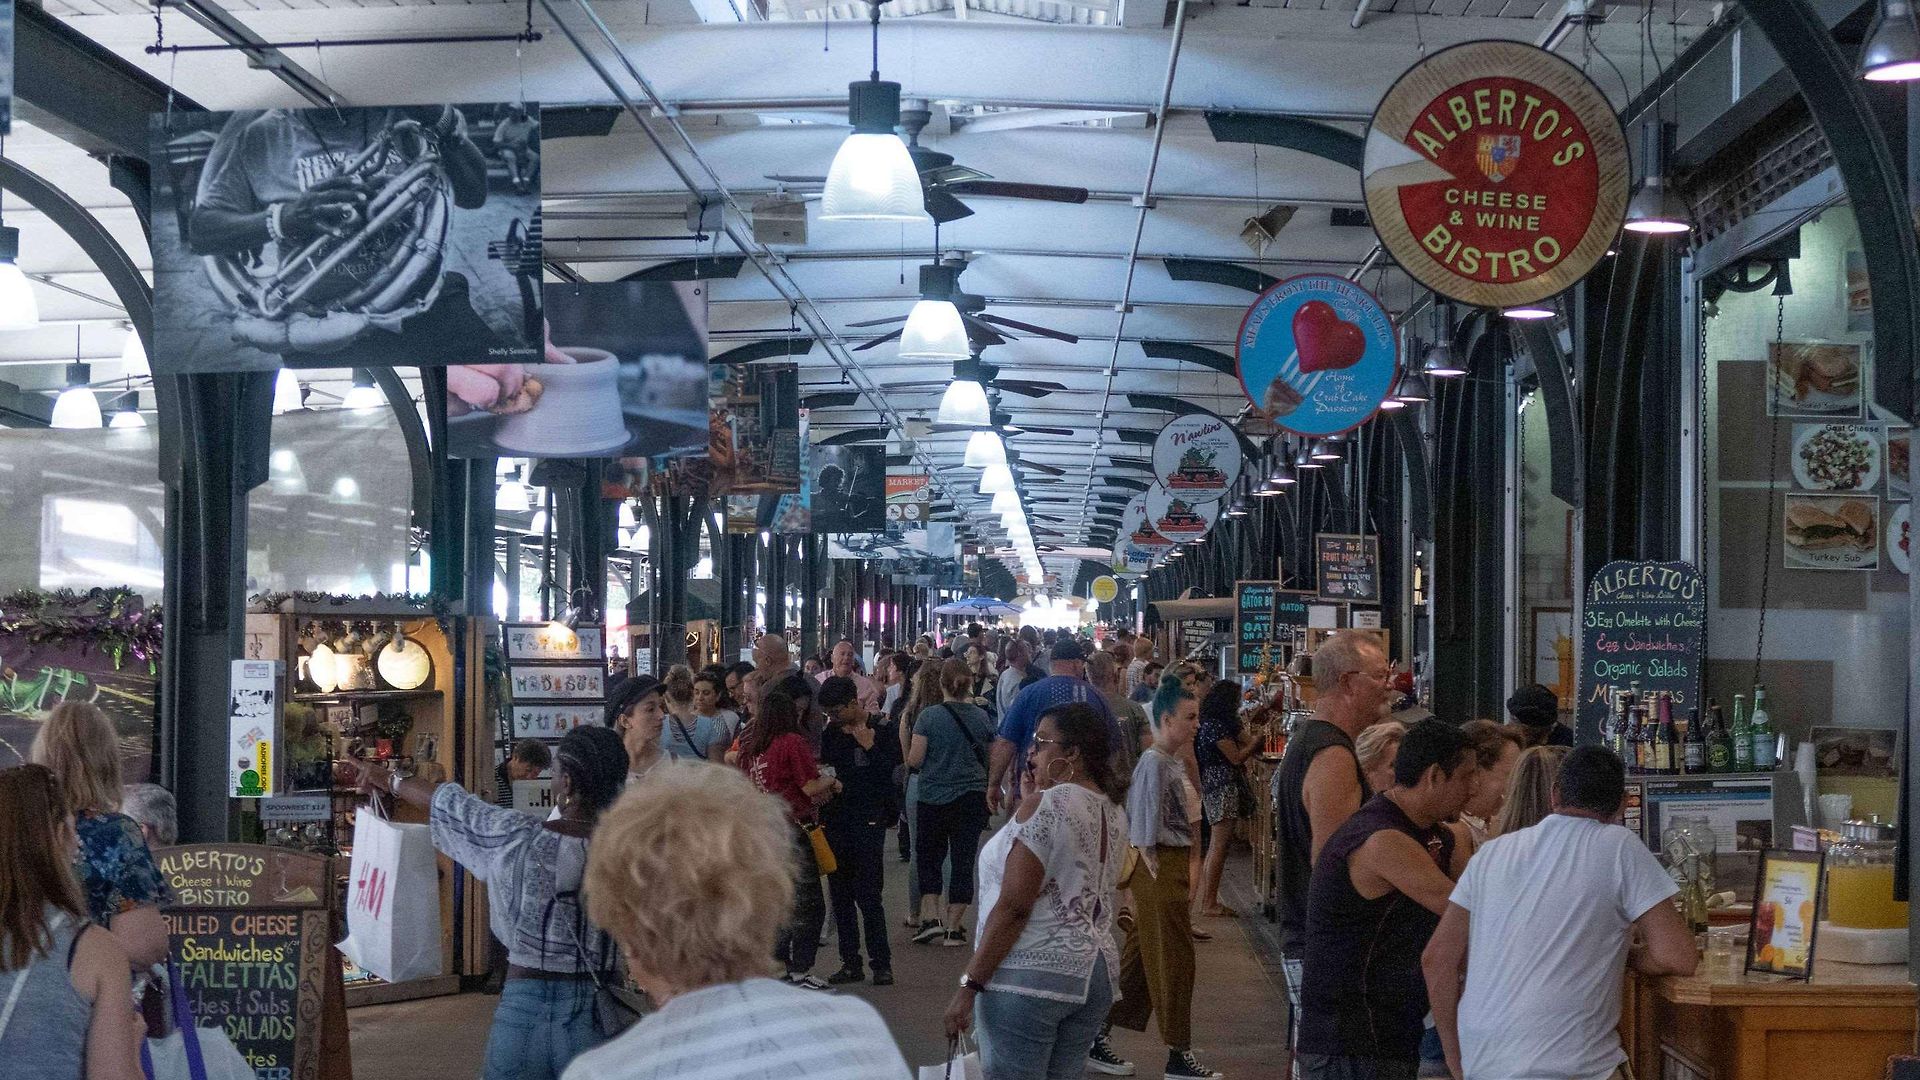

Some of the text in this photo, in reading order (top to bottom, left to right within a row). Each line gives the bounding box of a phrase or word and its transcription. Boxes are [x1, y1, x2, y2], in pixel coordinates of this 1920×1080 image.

[1412, 88, 1585, 167] ALBERTO'S
[1445, 188, 1548, 211] CHEESE
[1450, 211, 1541, 231] & WINE
[1422, 223, 1562, 279] BISTRO
[1269, 280, 1304, 309] FROM
[1325, 371, 1356, 382] Home
[1312, 391, 1369, 402] Crab Cake
[1335, 381, 1346, 393] of
[1314, 401, 1358, 415] Passion
[1825, 424, 1880, 433] Goat Cheese
[888, 478, 927, 486] MARKET
[1808, 552, 1862, 563] Turkey Sub
[1593, 566, 1699, 601] ALBERTO'S
[1241, 594, 1263, 609] GATOR
[1280, 603, 1305, 612] GATOR
[1586, 611, 1702, 628] 3 Egg Omelette with Cheese
[1596, 632, 1621, 653] Egg
[1623, 632, 1686, 652] Sandwiches
[1594, 657, 1689, 681] Organic Salads
[159, 850, 266, 876] ALBERTO'S
[171, 875, 213, 888] Cheese
[225, 875, 253, 889] Wine
[178, 888, 250, 906] BISTRO
[161, 914, 298, 936] RILLED CHEESE
[181, 938, 285, 963] Sandwiches
[247, 990, 290, 1016] Subs
[225, 1014, 296, 1041] SALADS
